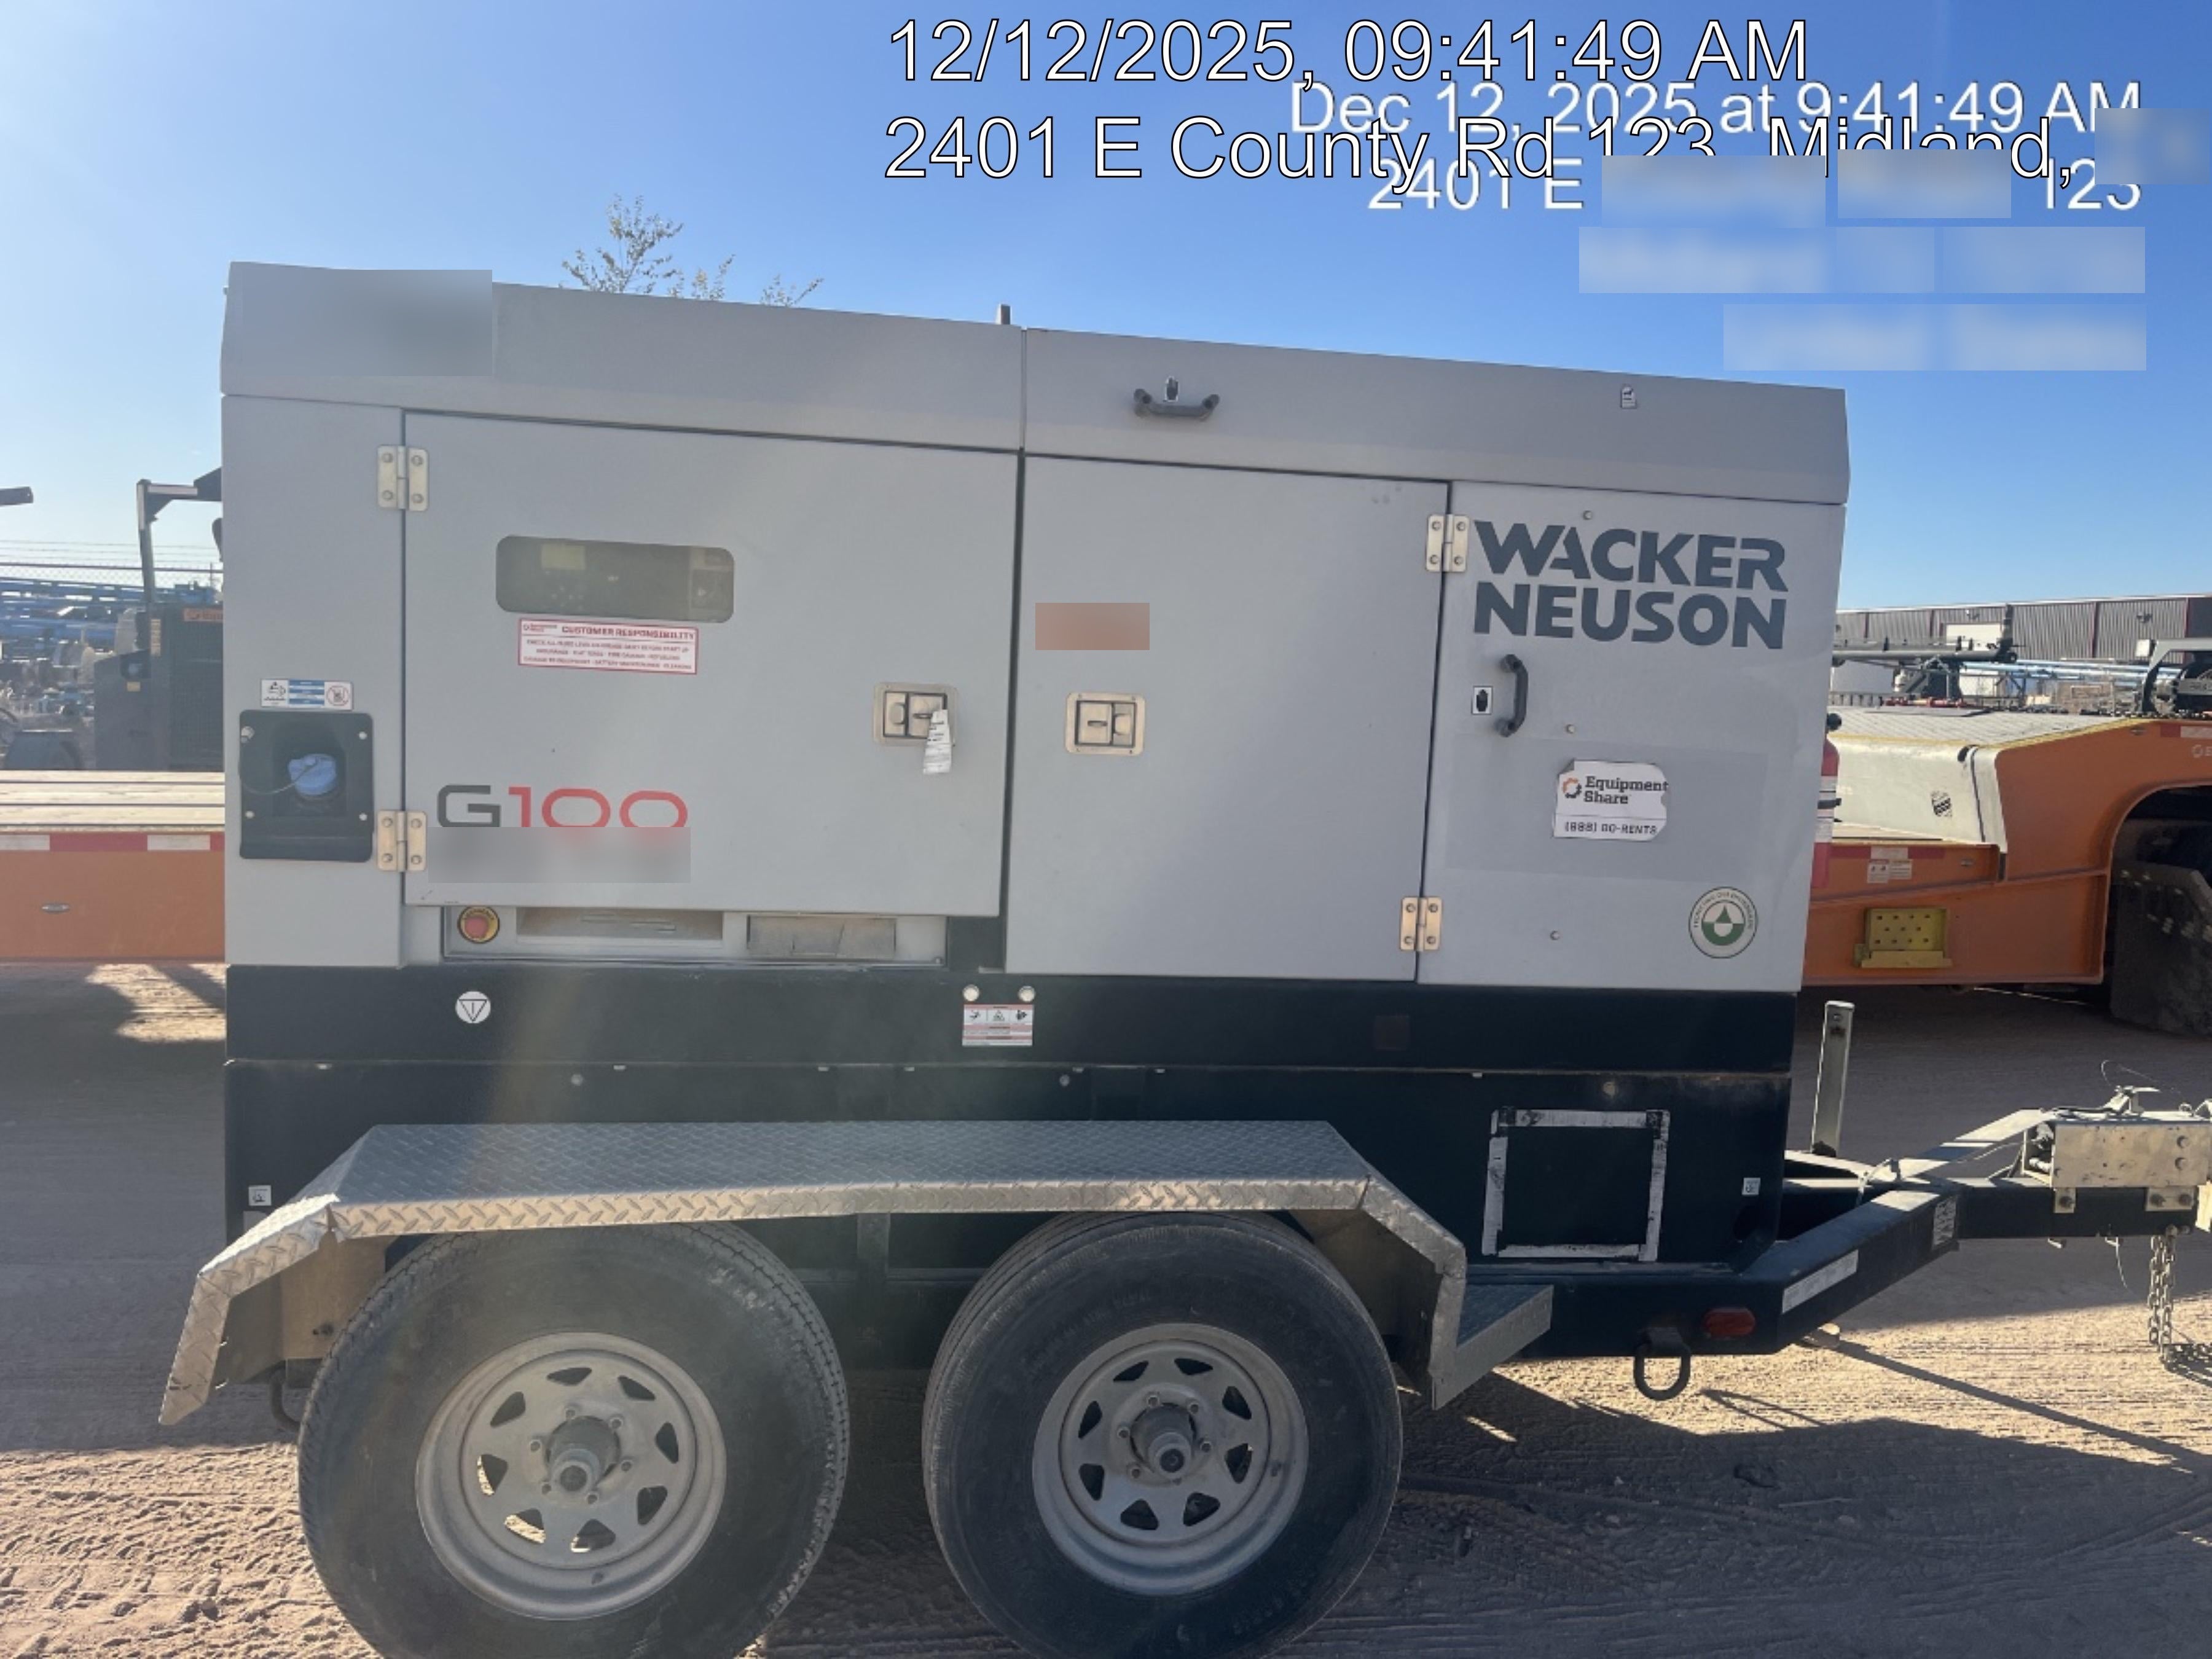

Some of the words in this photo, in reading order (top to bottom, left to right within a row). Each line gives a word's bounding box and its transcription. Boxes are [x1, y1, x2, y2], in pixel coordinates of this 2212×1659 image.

[1473, 520, 1788, 592] WACKER
[1473, 581, 1786, 649] NEUSON
[562, 626, 614, 636] CUSTOMER
[1583, 791, 1629, 804] Share
[1585, 776, 1669, 793] Equipment
[437, 784, 688, 828] G100
